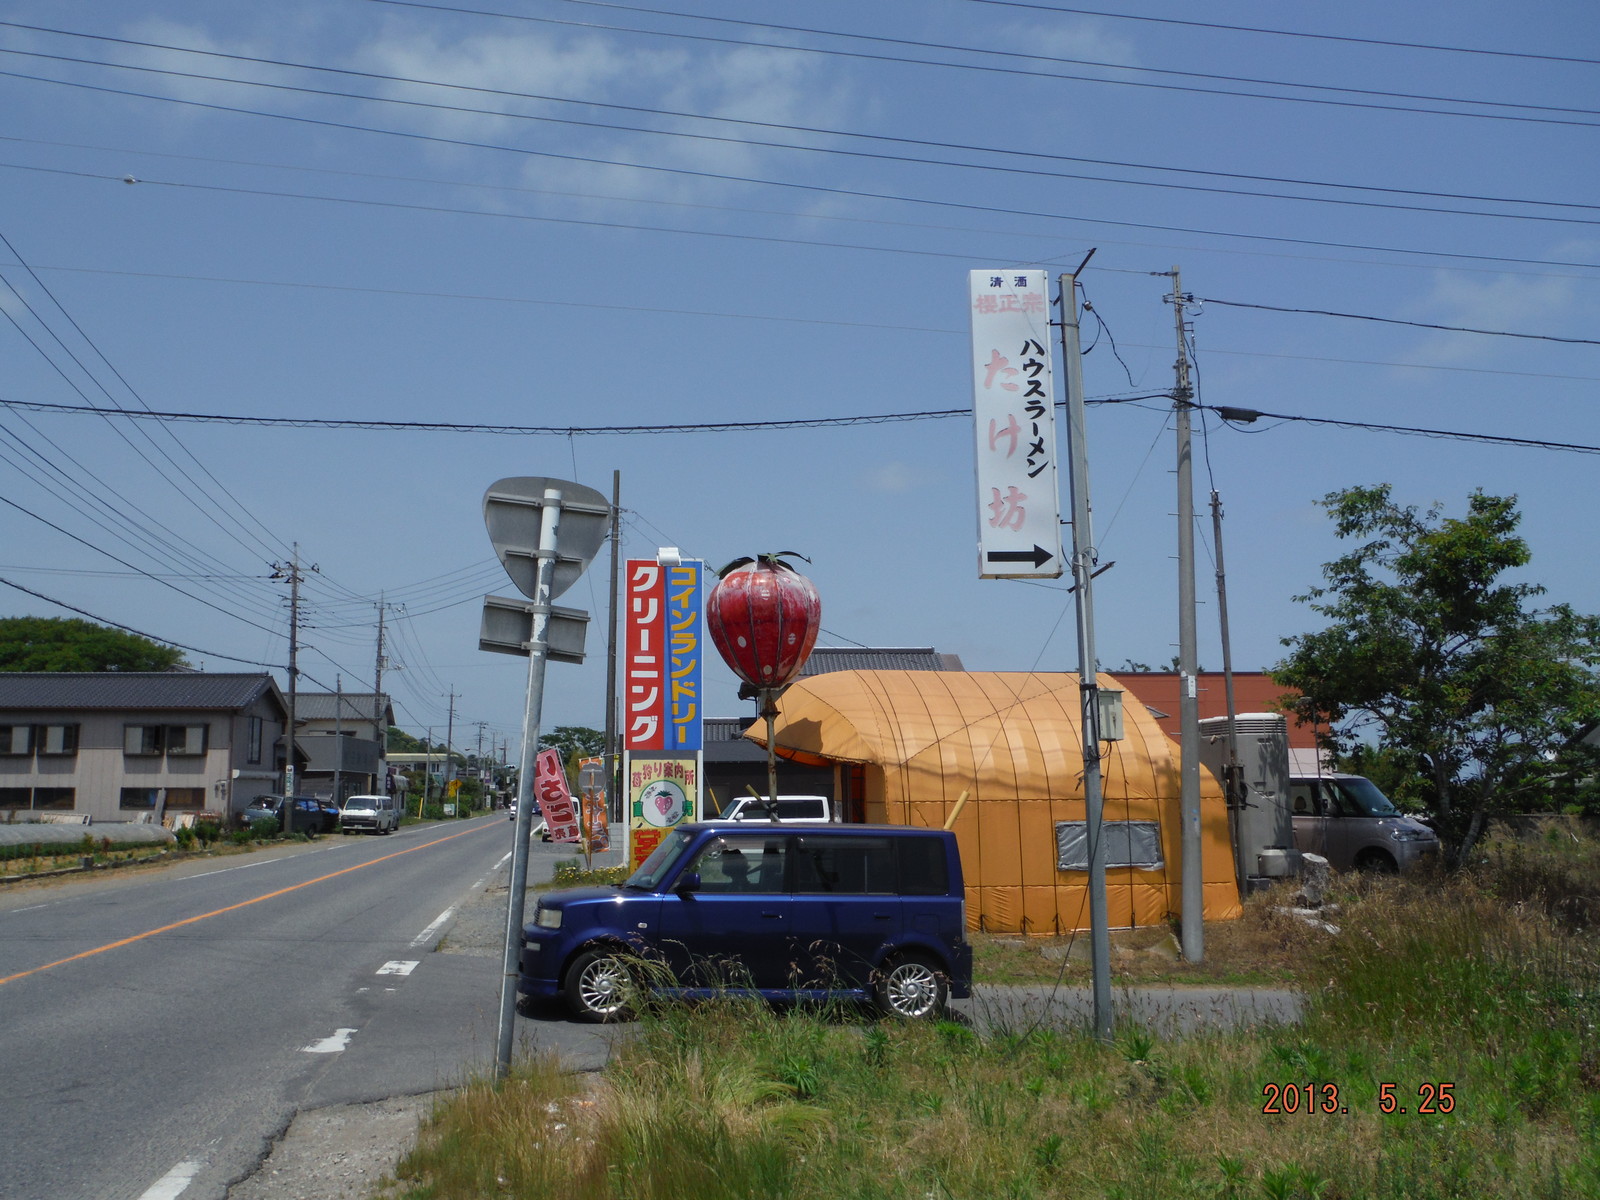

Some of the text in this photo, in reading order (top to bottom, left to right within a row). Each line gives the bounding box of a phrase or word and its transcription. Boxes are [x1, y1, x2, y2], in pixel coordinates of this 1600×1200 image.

[990, 276, 1027, 288] 清酒
[984, 349, 1027, 532] たけ坊
[1020, 338, 1049, 478] ハウスラーメン
[631, 566, 658, 742] クリーニング
[671, 567, 696, 743] コインランドリー
